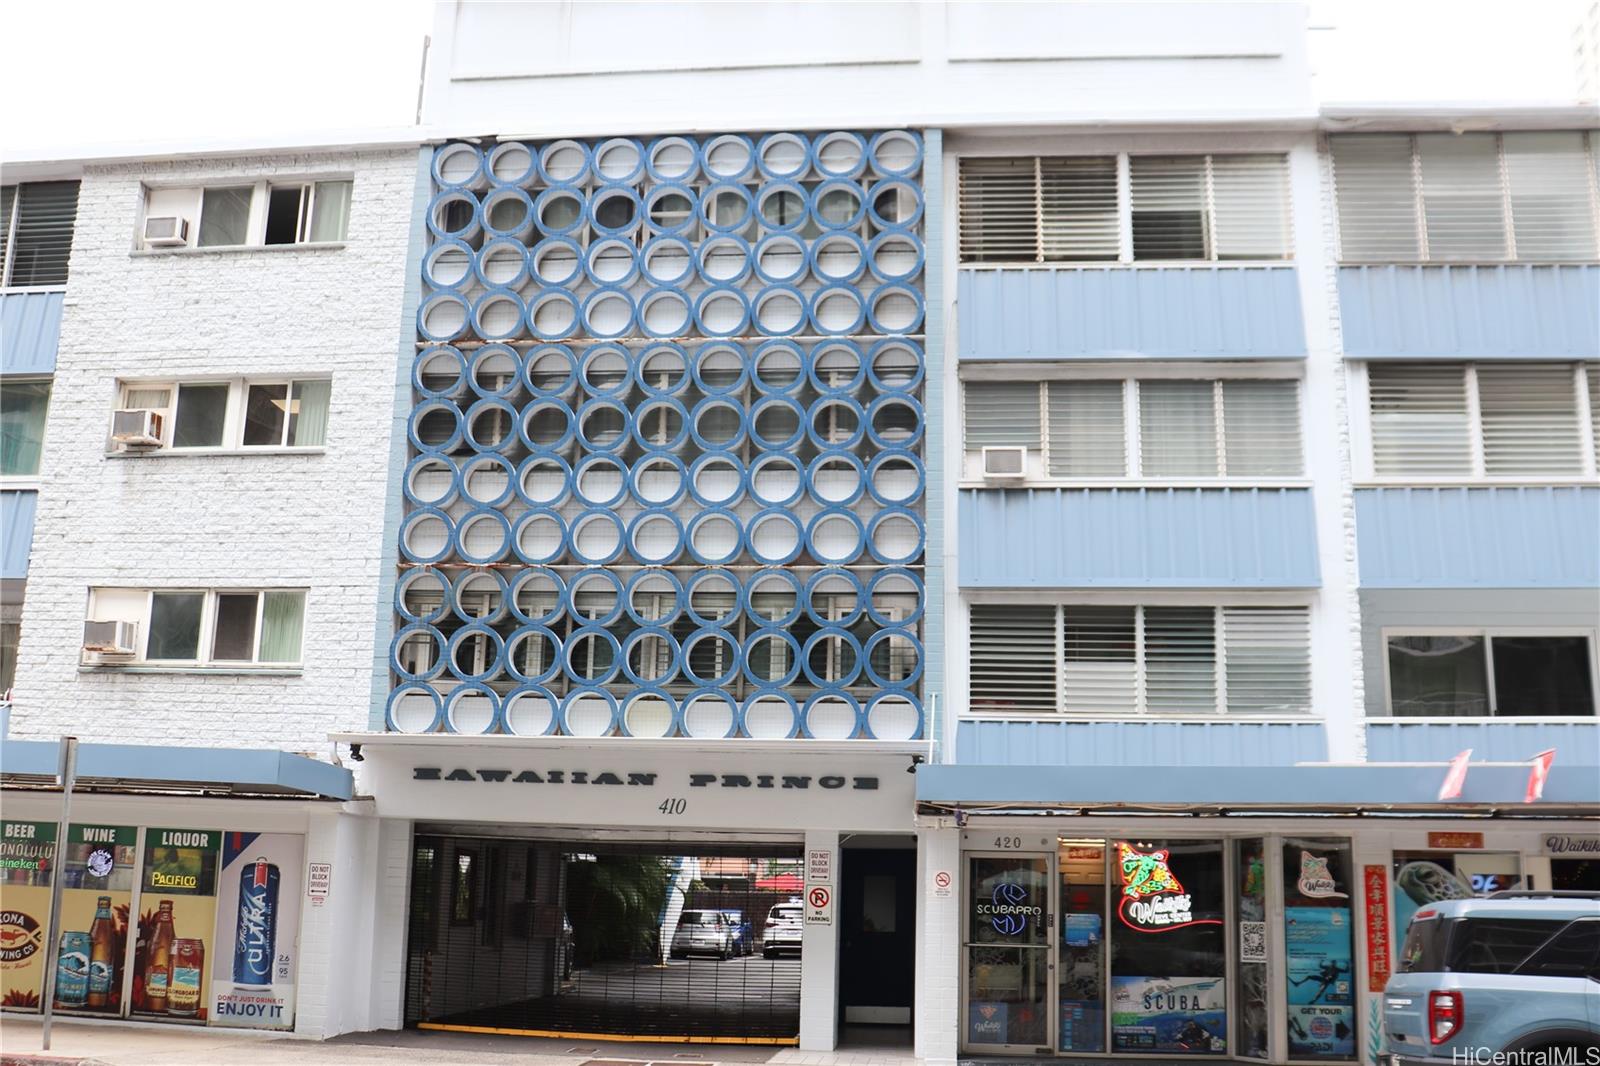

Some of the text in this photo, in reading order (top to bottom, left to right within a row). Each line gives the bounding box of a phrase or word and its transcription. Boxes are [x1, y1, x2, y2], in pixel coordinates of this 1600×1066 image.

[413, 768, 879, 790] HAWAIIAN PRINCE
[658, 798, 687, 815] 410
[5, 823, 36, 839] BEER
[83, 827, 116, 843] WINE
[161, 831, 209, 847] LIQUOR
[994, 837, 1022, 849] 420
[976, 904, 1042, 915] SCUBAPRO
[247, 892, 267, 963] ULTRA
[278, 967, 289, 975] 95
[217, 1002, 284, 1018] ENJOY IT
[1143, 994, 1201, 1011] SCUBA
[1300, 1007, 1344, 1015] GET YOUR
